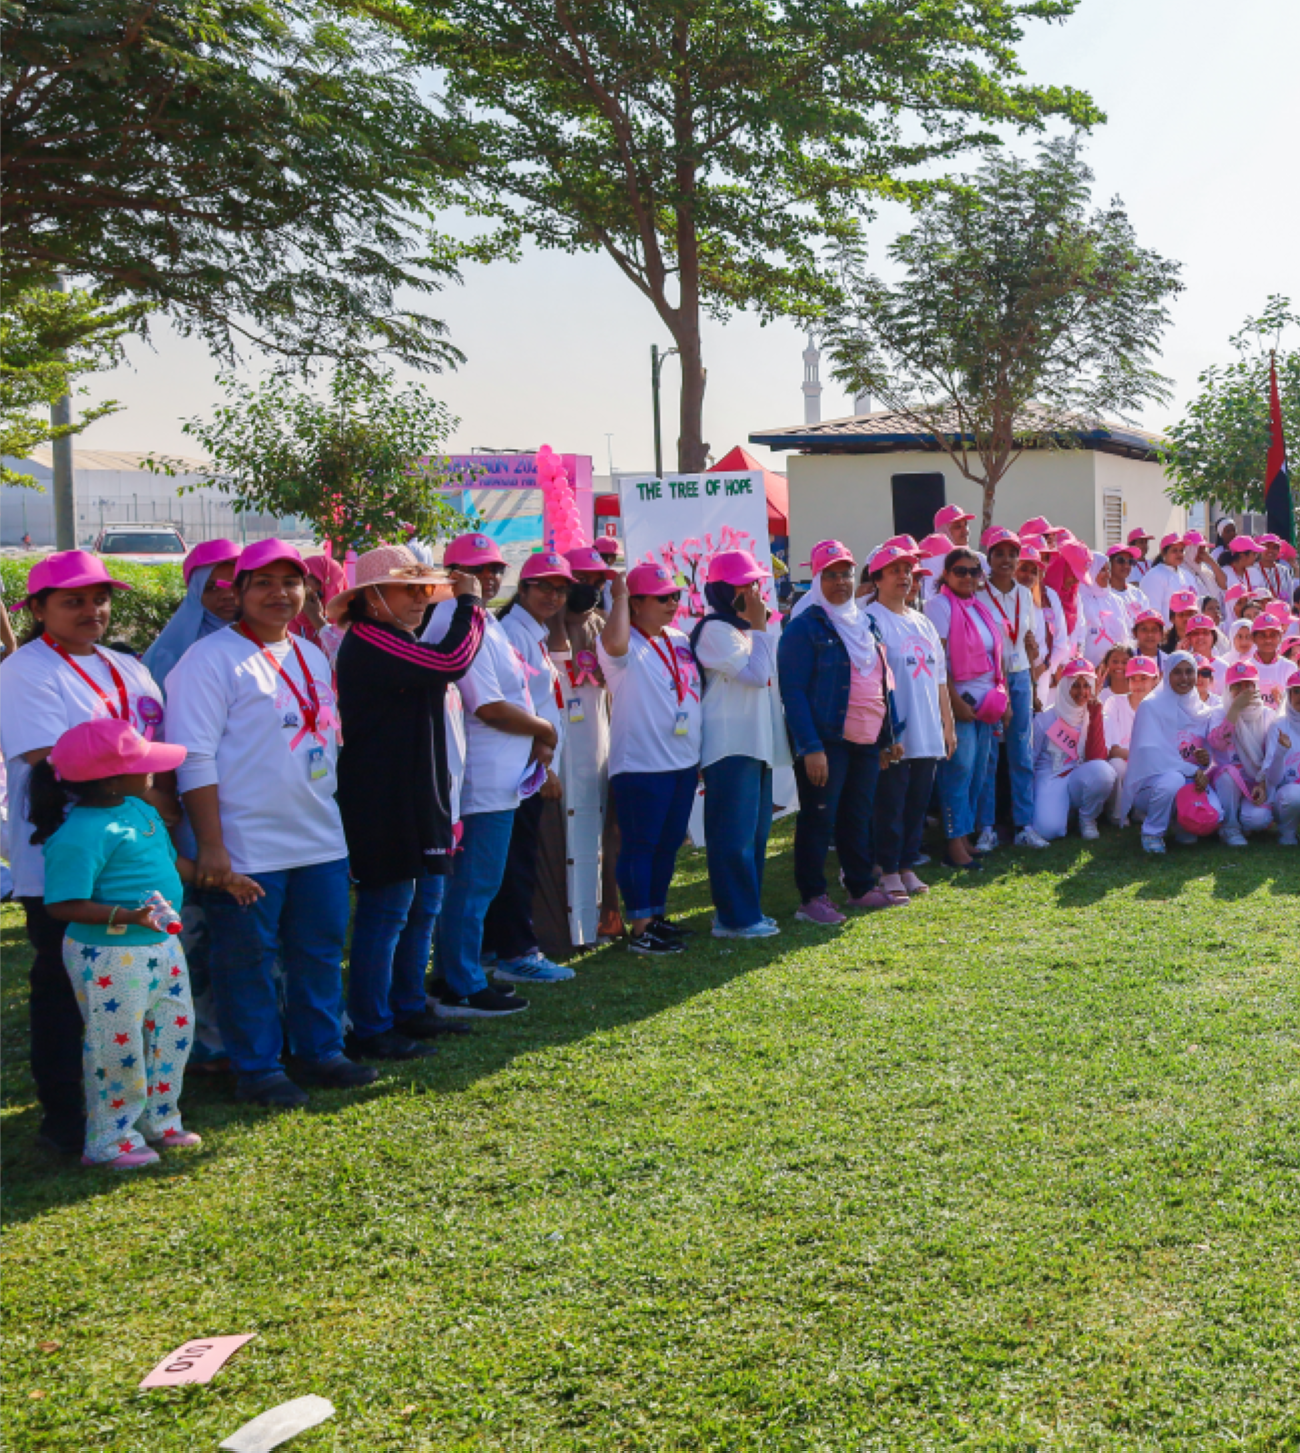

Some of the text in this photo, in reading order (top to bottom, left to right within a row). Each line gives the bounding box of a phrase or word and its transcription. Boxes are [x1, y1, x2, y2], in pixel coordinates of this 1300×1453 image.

[514, 457, 539, 474] 202
[636, 477, 754, 502] THE TREE OF HOPE
